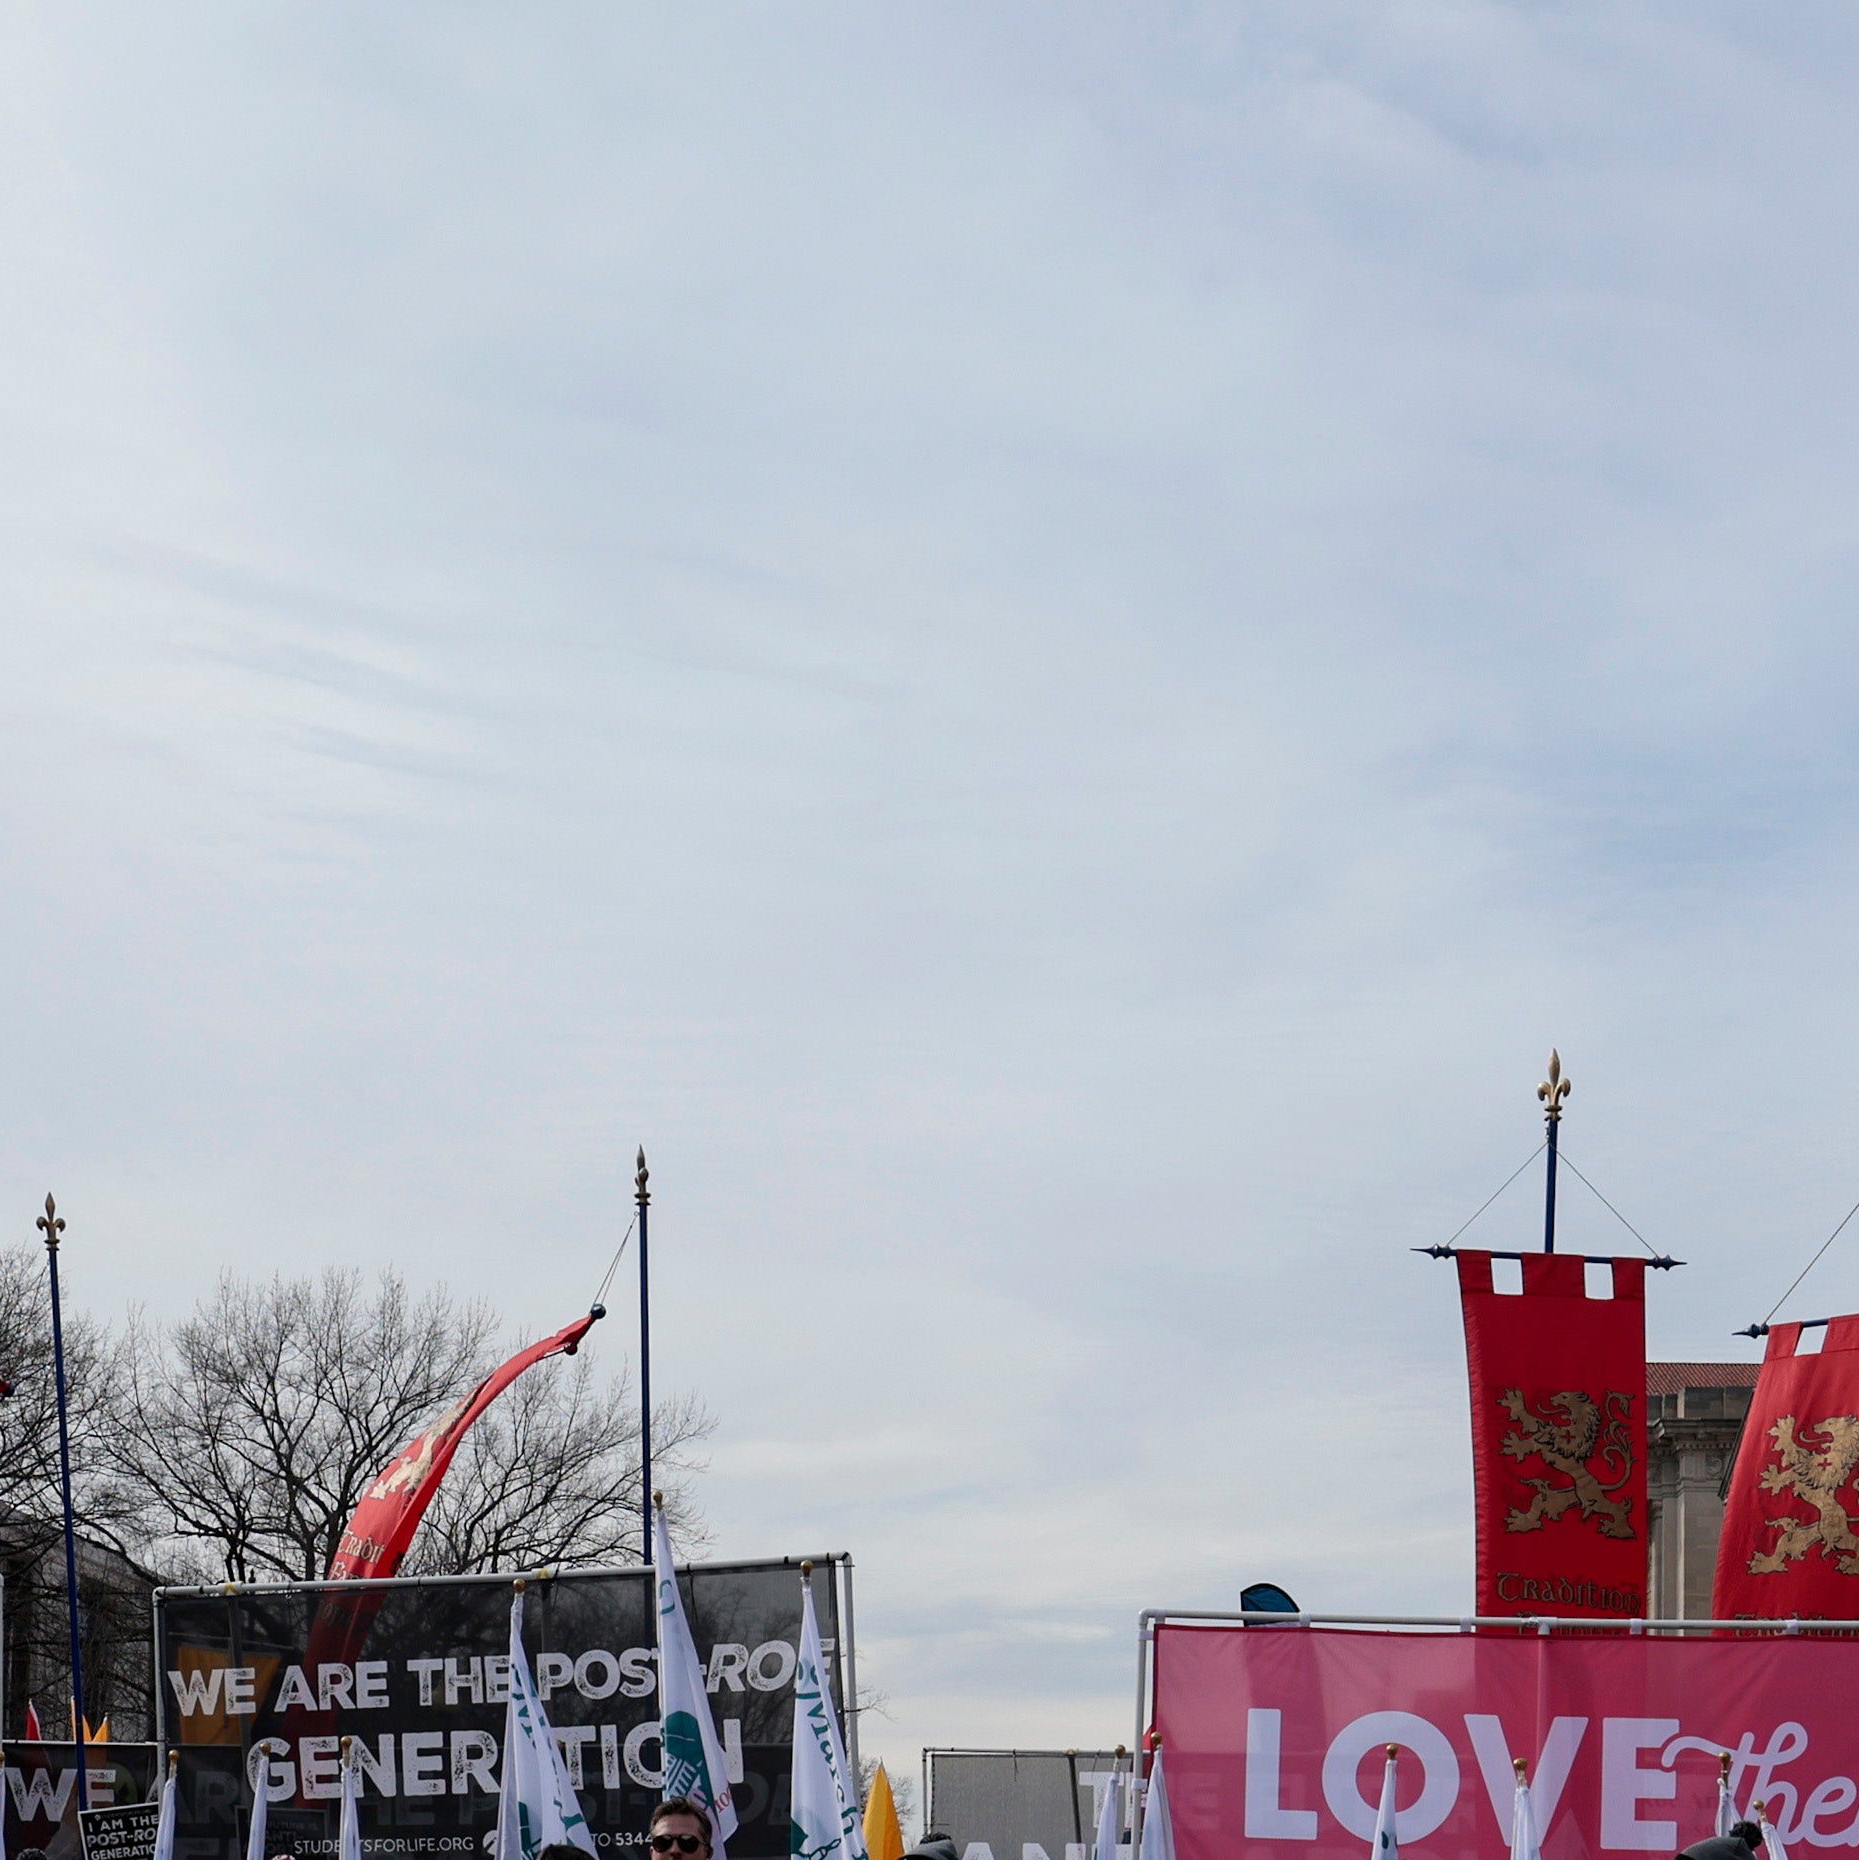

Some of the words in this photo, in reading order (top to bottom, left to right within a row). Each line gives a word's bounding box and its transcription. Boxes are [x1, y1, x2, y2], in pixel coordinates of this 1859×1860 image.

[167, 1667, 257, 1717] WE
[273, 1660, 390, 1714] ARE
[406, 1655, 512, 1707] THE
[1244, 1708, 1680, 1851] LOVE
[100, 1815, 125, 1830] AM
[86, 1827, 158, 1849] POST-RO
[294, 1836, 475, 1854] STUDETSFORLIFE.ORG
[614, 1832, 654, 1848] 5344
